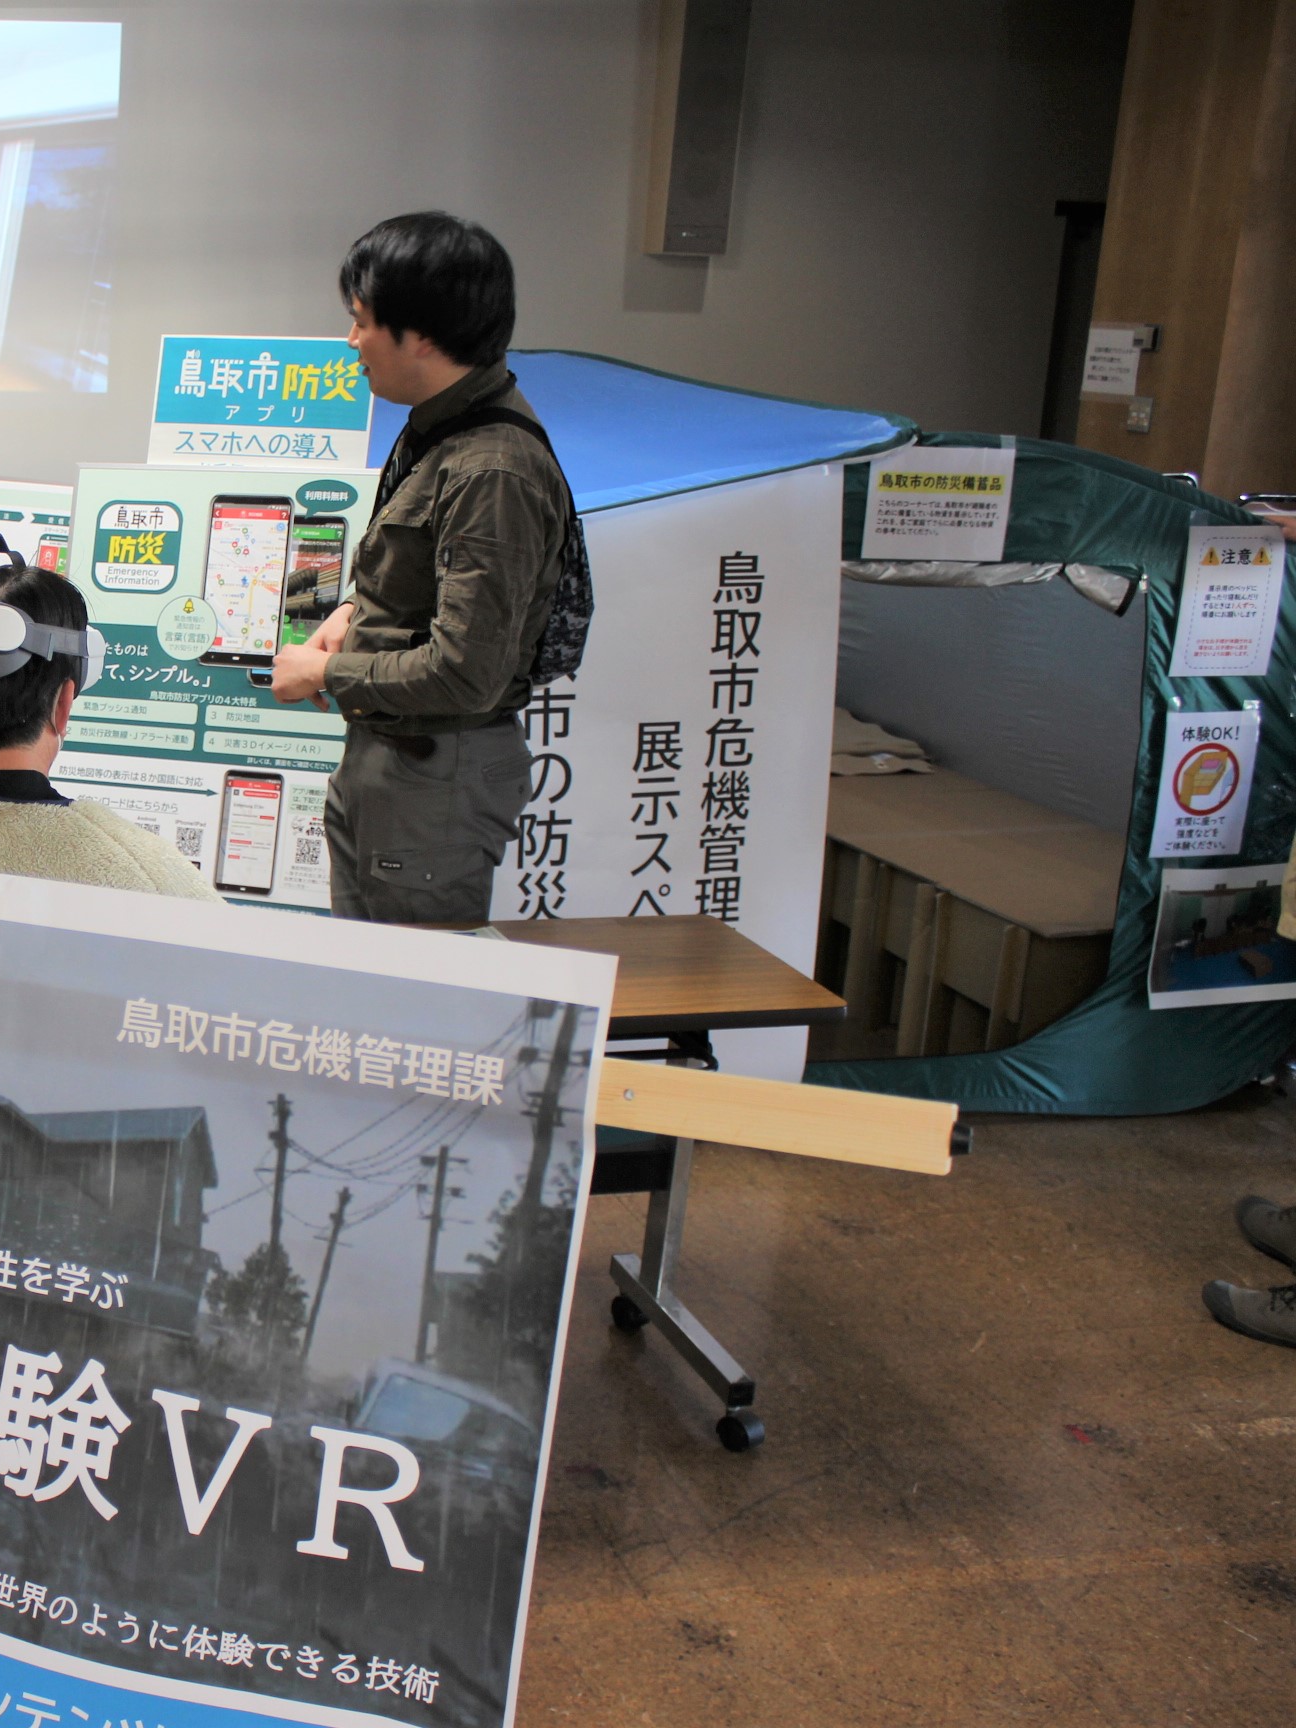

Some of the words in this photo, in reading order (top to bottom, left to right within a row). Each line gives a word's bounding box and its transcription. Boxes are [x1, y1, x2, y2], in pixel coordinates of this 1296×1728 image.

[174, 349, 361, 401] 鳥取市防災
[225, 404, 305, 424] アプリ
[175, 431, 339, 459] スマホへの導入
[879, 472, 1002, 492] 鳥取市の防災備蓄品
[305, 490, 349, 502] 利用料無料
[114, 506, 165, 529] 鳥取市
[108, 531, 167, 565] 防災
[1221, 548, 1253, 565] 注意
[104, 575, 160, 586] Information
[107, 566, 159, 577] Emergency
[98, 664, 211, 688] て、シンプル。」
[83, 701, 148, 715] 緊急プッシュ通知
[210, 711, 217, 720] 3
[225, 711, 261, 723] 防災地図
[208, 738, 215, 746] 4
[695, 550, 765, 930] 鳥取市危機管理
[1182, 725, 1241, 742] 体験OK!
[517, 670, 576, 920] 市の防災
[116, 997, 505, 1106] 鳥取市危機管理課
